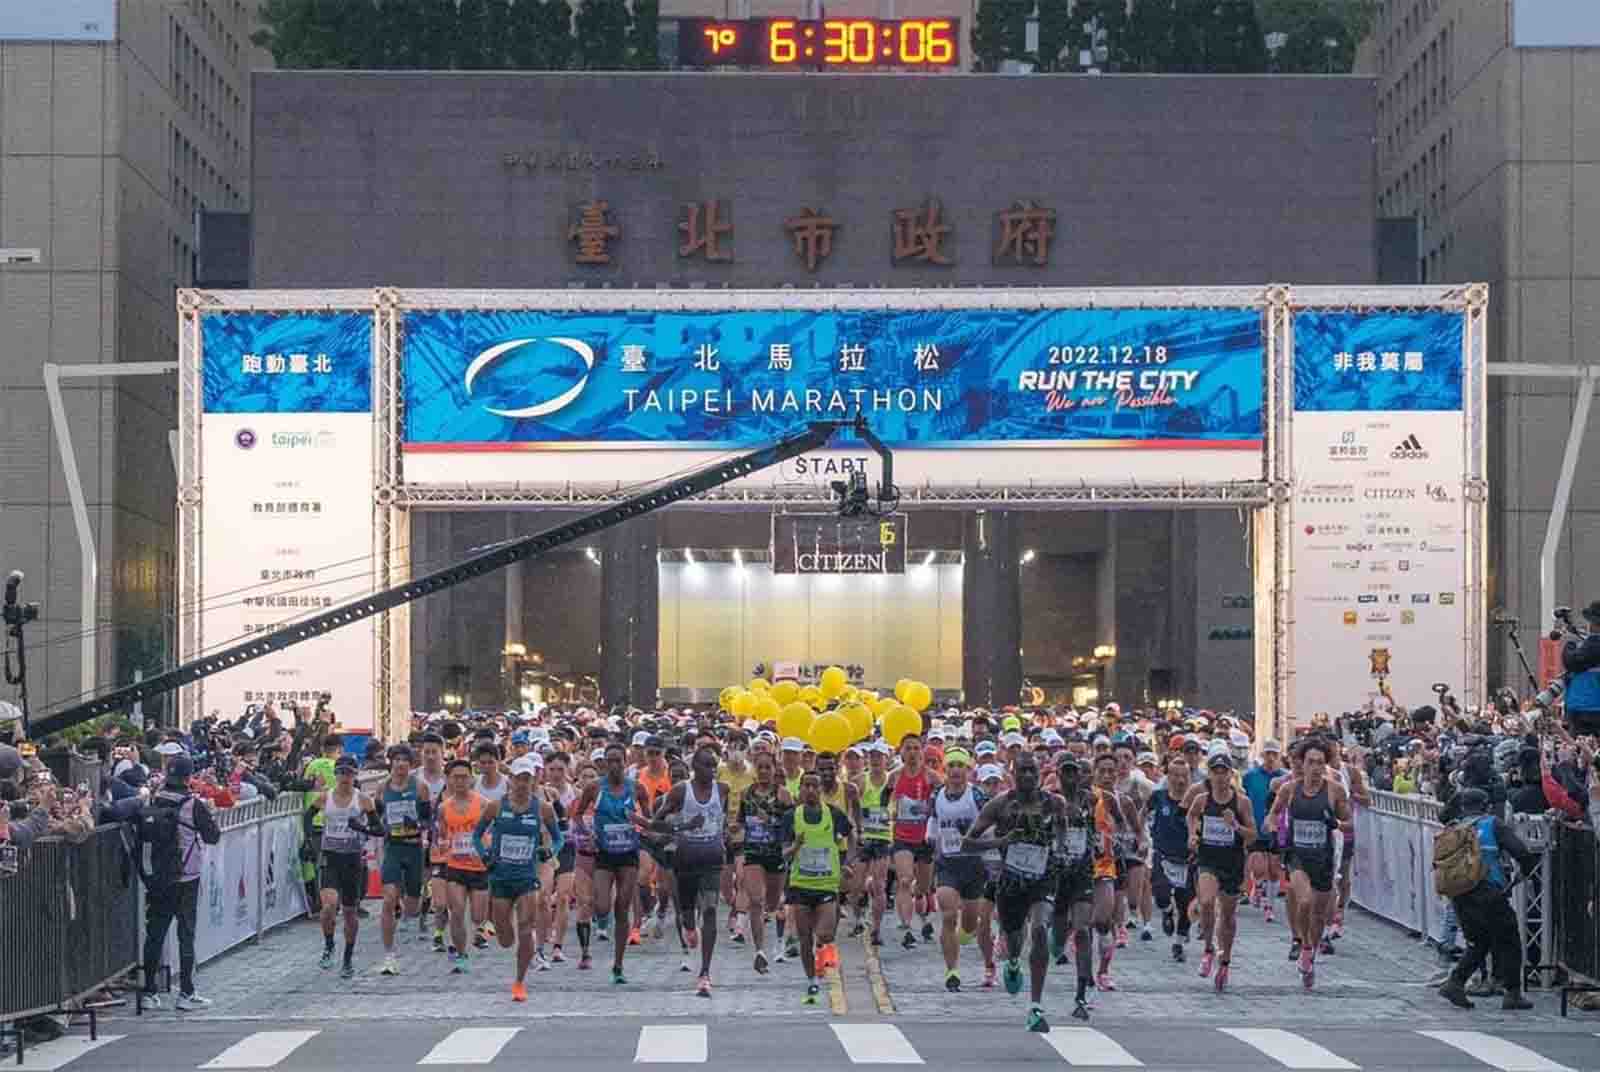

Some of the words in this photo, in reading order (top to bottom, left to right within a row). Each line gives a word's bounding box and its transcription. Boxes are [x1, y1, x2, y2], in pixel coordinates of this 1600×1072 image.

[769, 20, 953, 63] 6:30:06
[566, 200, 1058, 271] 臺北市政府
[242, 353, 333, 374] 跑動臺北
[620, 343, 940, 373] 臺北馬拉松
[1048, 345, 1168, 364] 2022.12.18
[1333, 351, 1424, 372] 非我莫屬
[1018, 370, 1077, 391] RUN
[1082, 370, 1132, 391] THE
[1139, 370, 1199, 391] CITY
[624, 389, 733, 412] TAIPEI
[752, 387, 942, 412] MARATHON
[271, 430, 313, 448] taipei
[1389, 450, 1429, 460] adidas
[795, 457, 868, 475] START
[1364, 487, 1415, 500] CITIZEN
[799, 553, 882, 571] CITIZEN
